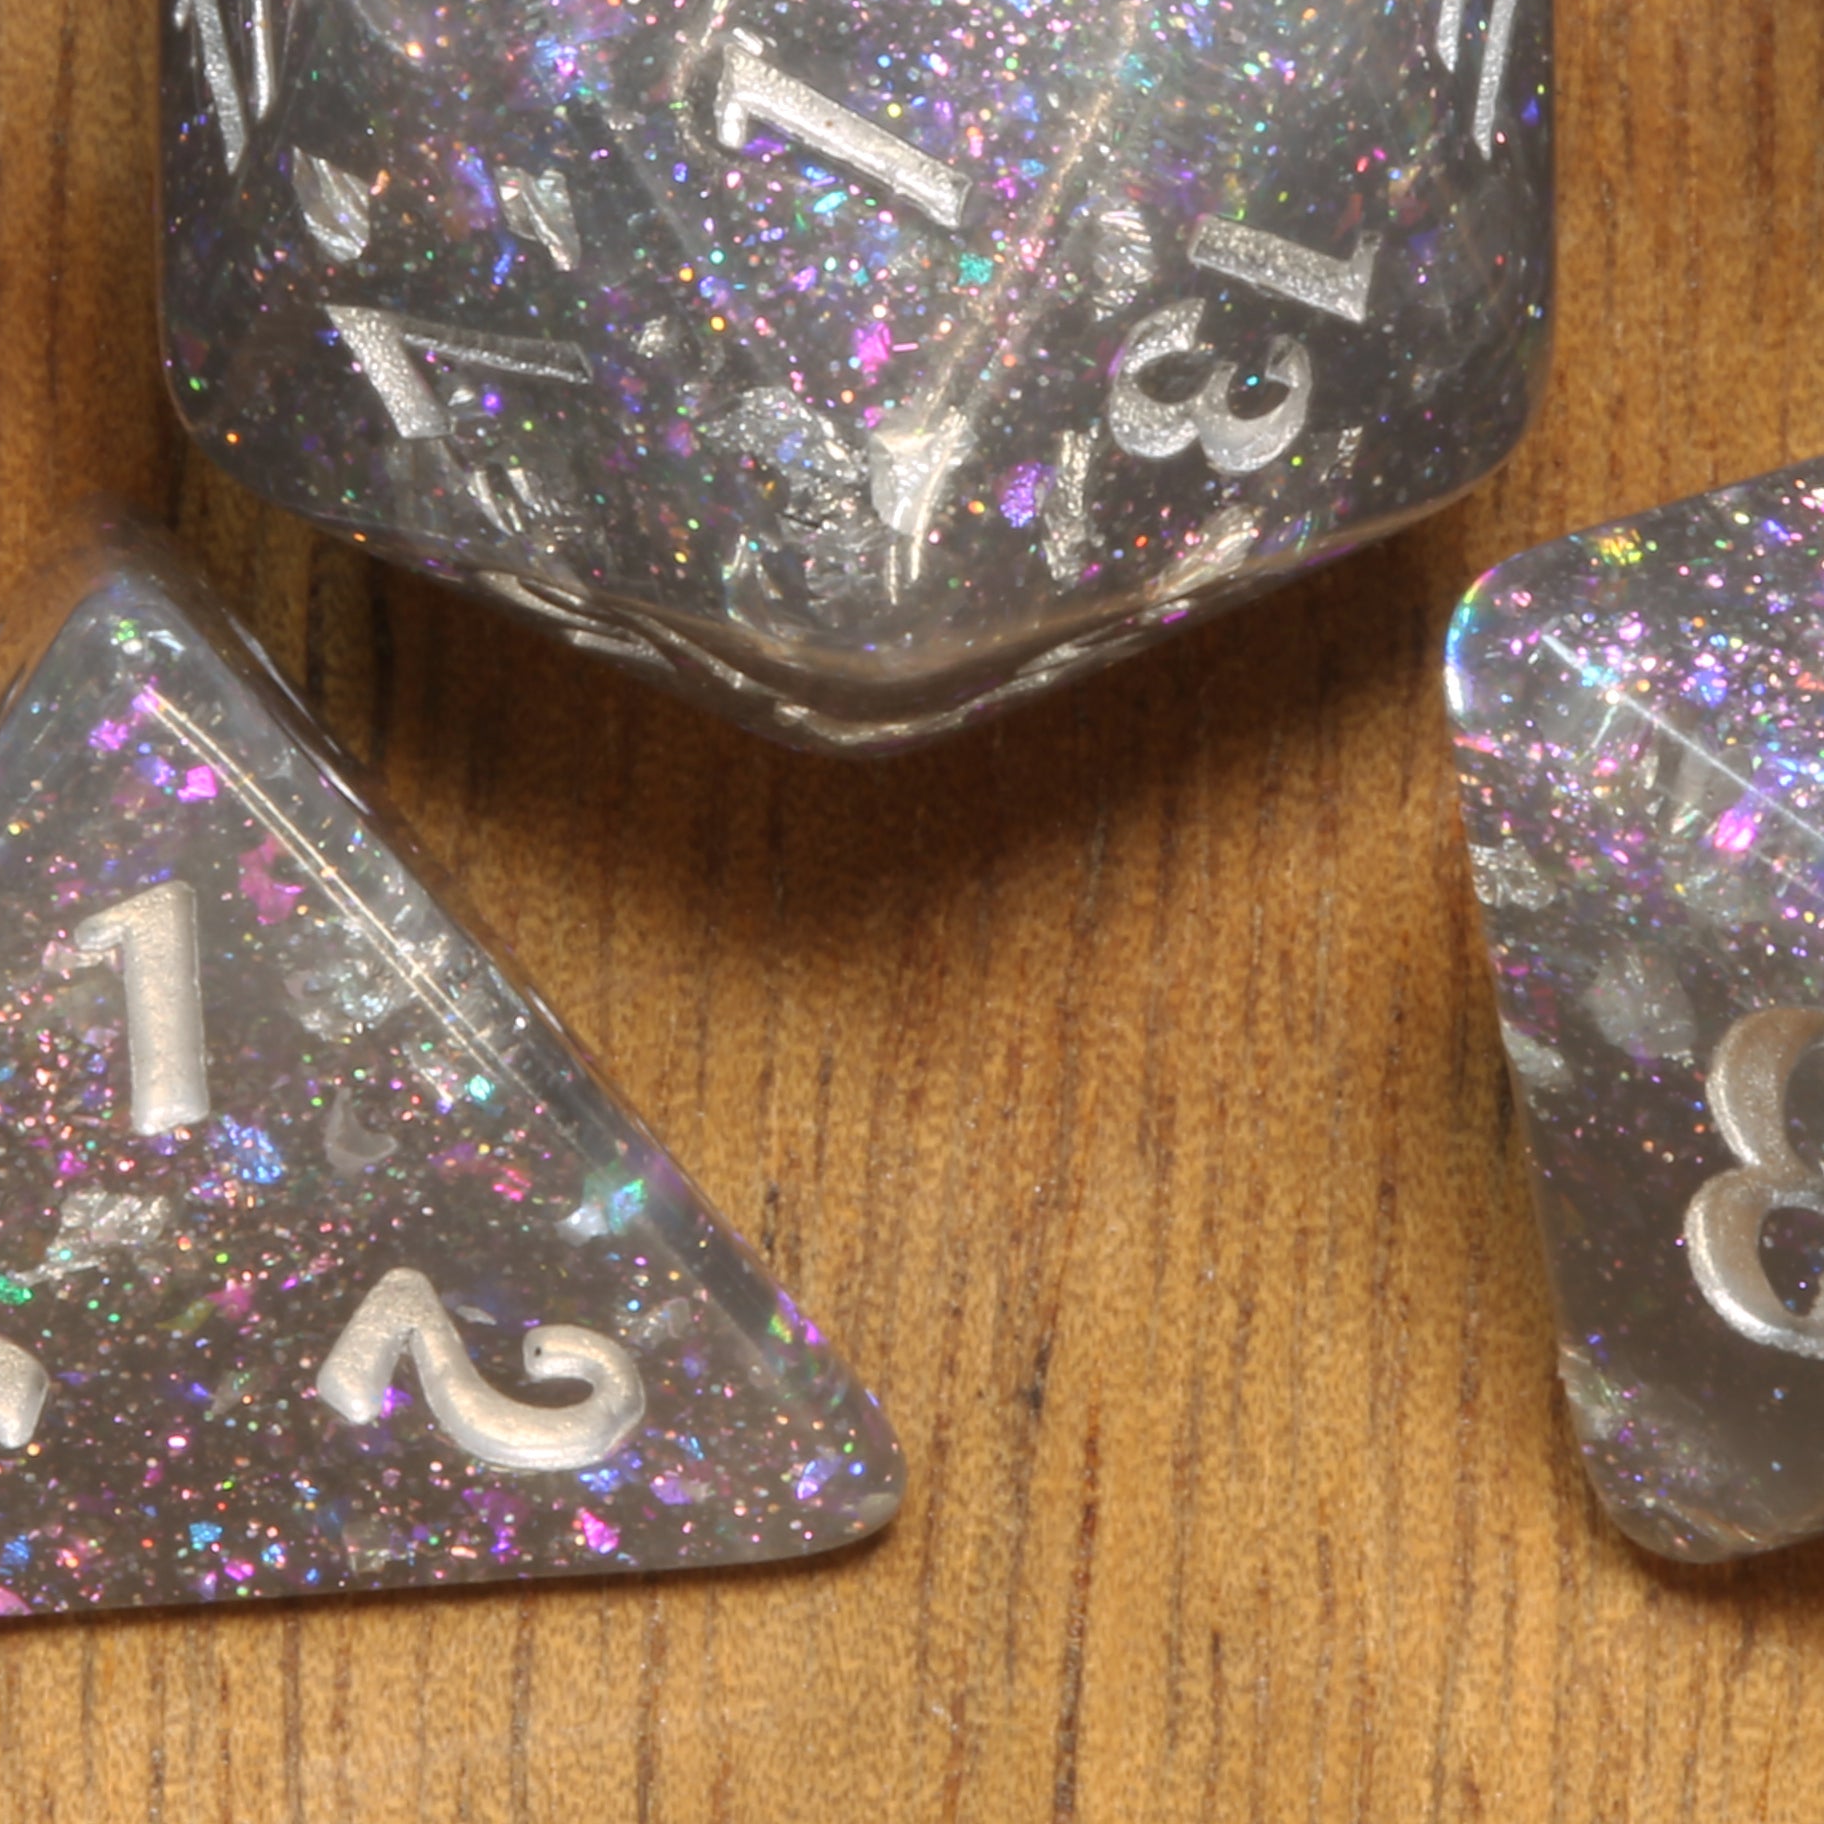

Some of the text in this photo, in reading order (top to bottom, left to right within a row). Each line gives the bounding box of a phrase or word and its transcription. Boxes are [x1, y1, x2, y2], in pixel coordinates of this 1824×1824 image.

[714, 31, 976, 231] 1
[1107, 212, 1384, 474] 13
[73, 878, 212, 1137] 1
[314, 1265, 646, 1473] 2
